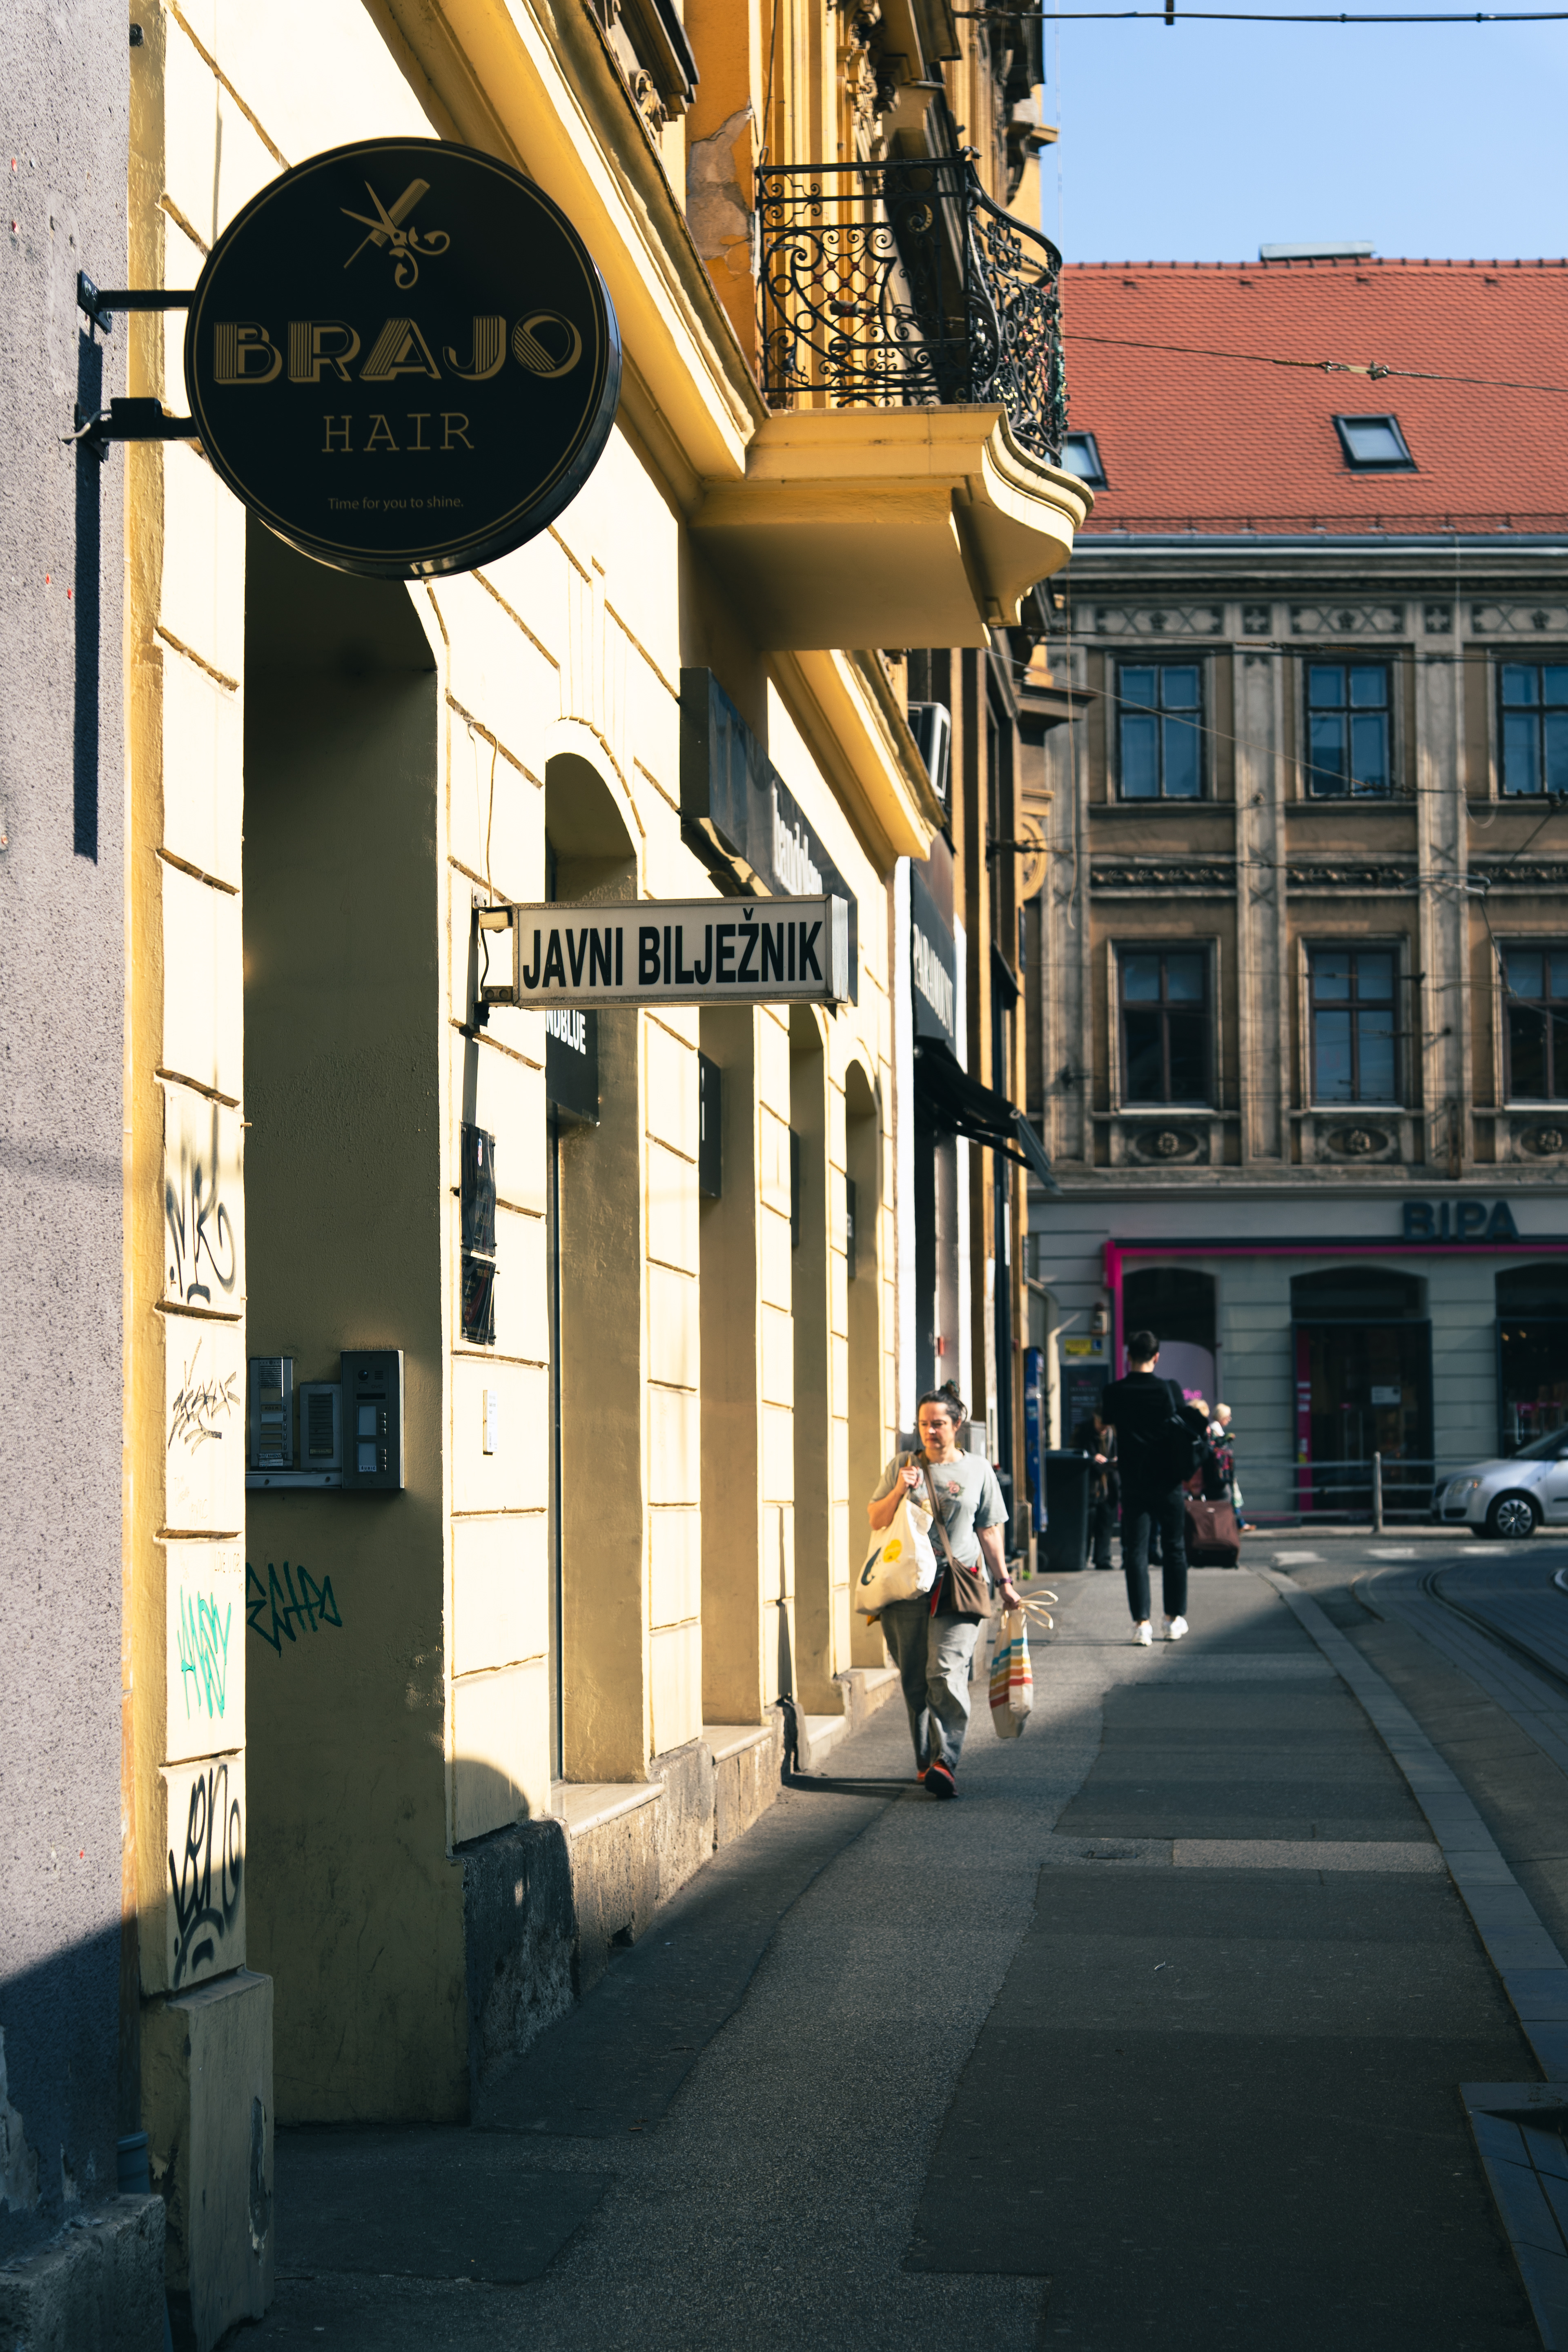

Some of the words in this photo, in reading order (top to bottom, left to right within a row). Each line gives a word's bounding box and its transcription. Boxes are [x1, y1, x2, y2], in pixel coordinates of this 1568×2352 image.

[213, 308, 583, 385] BRAJO
[321, 413, 475, 453] HAIR
[328, 498, 359, 510] Time
[362, 497, 380, 510] for
[383, 499, 406, 512] you
[410, 497, 423, 508] to
[427, 495, 464, 508] shine.
[523, 927, 624, 989] JAVNI
[638, 907, 823, 986] BILJEŽNIK
[1403, 1200, 1519, 1241] BIPA
